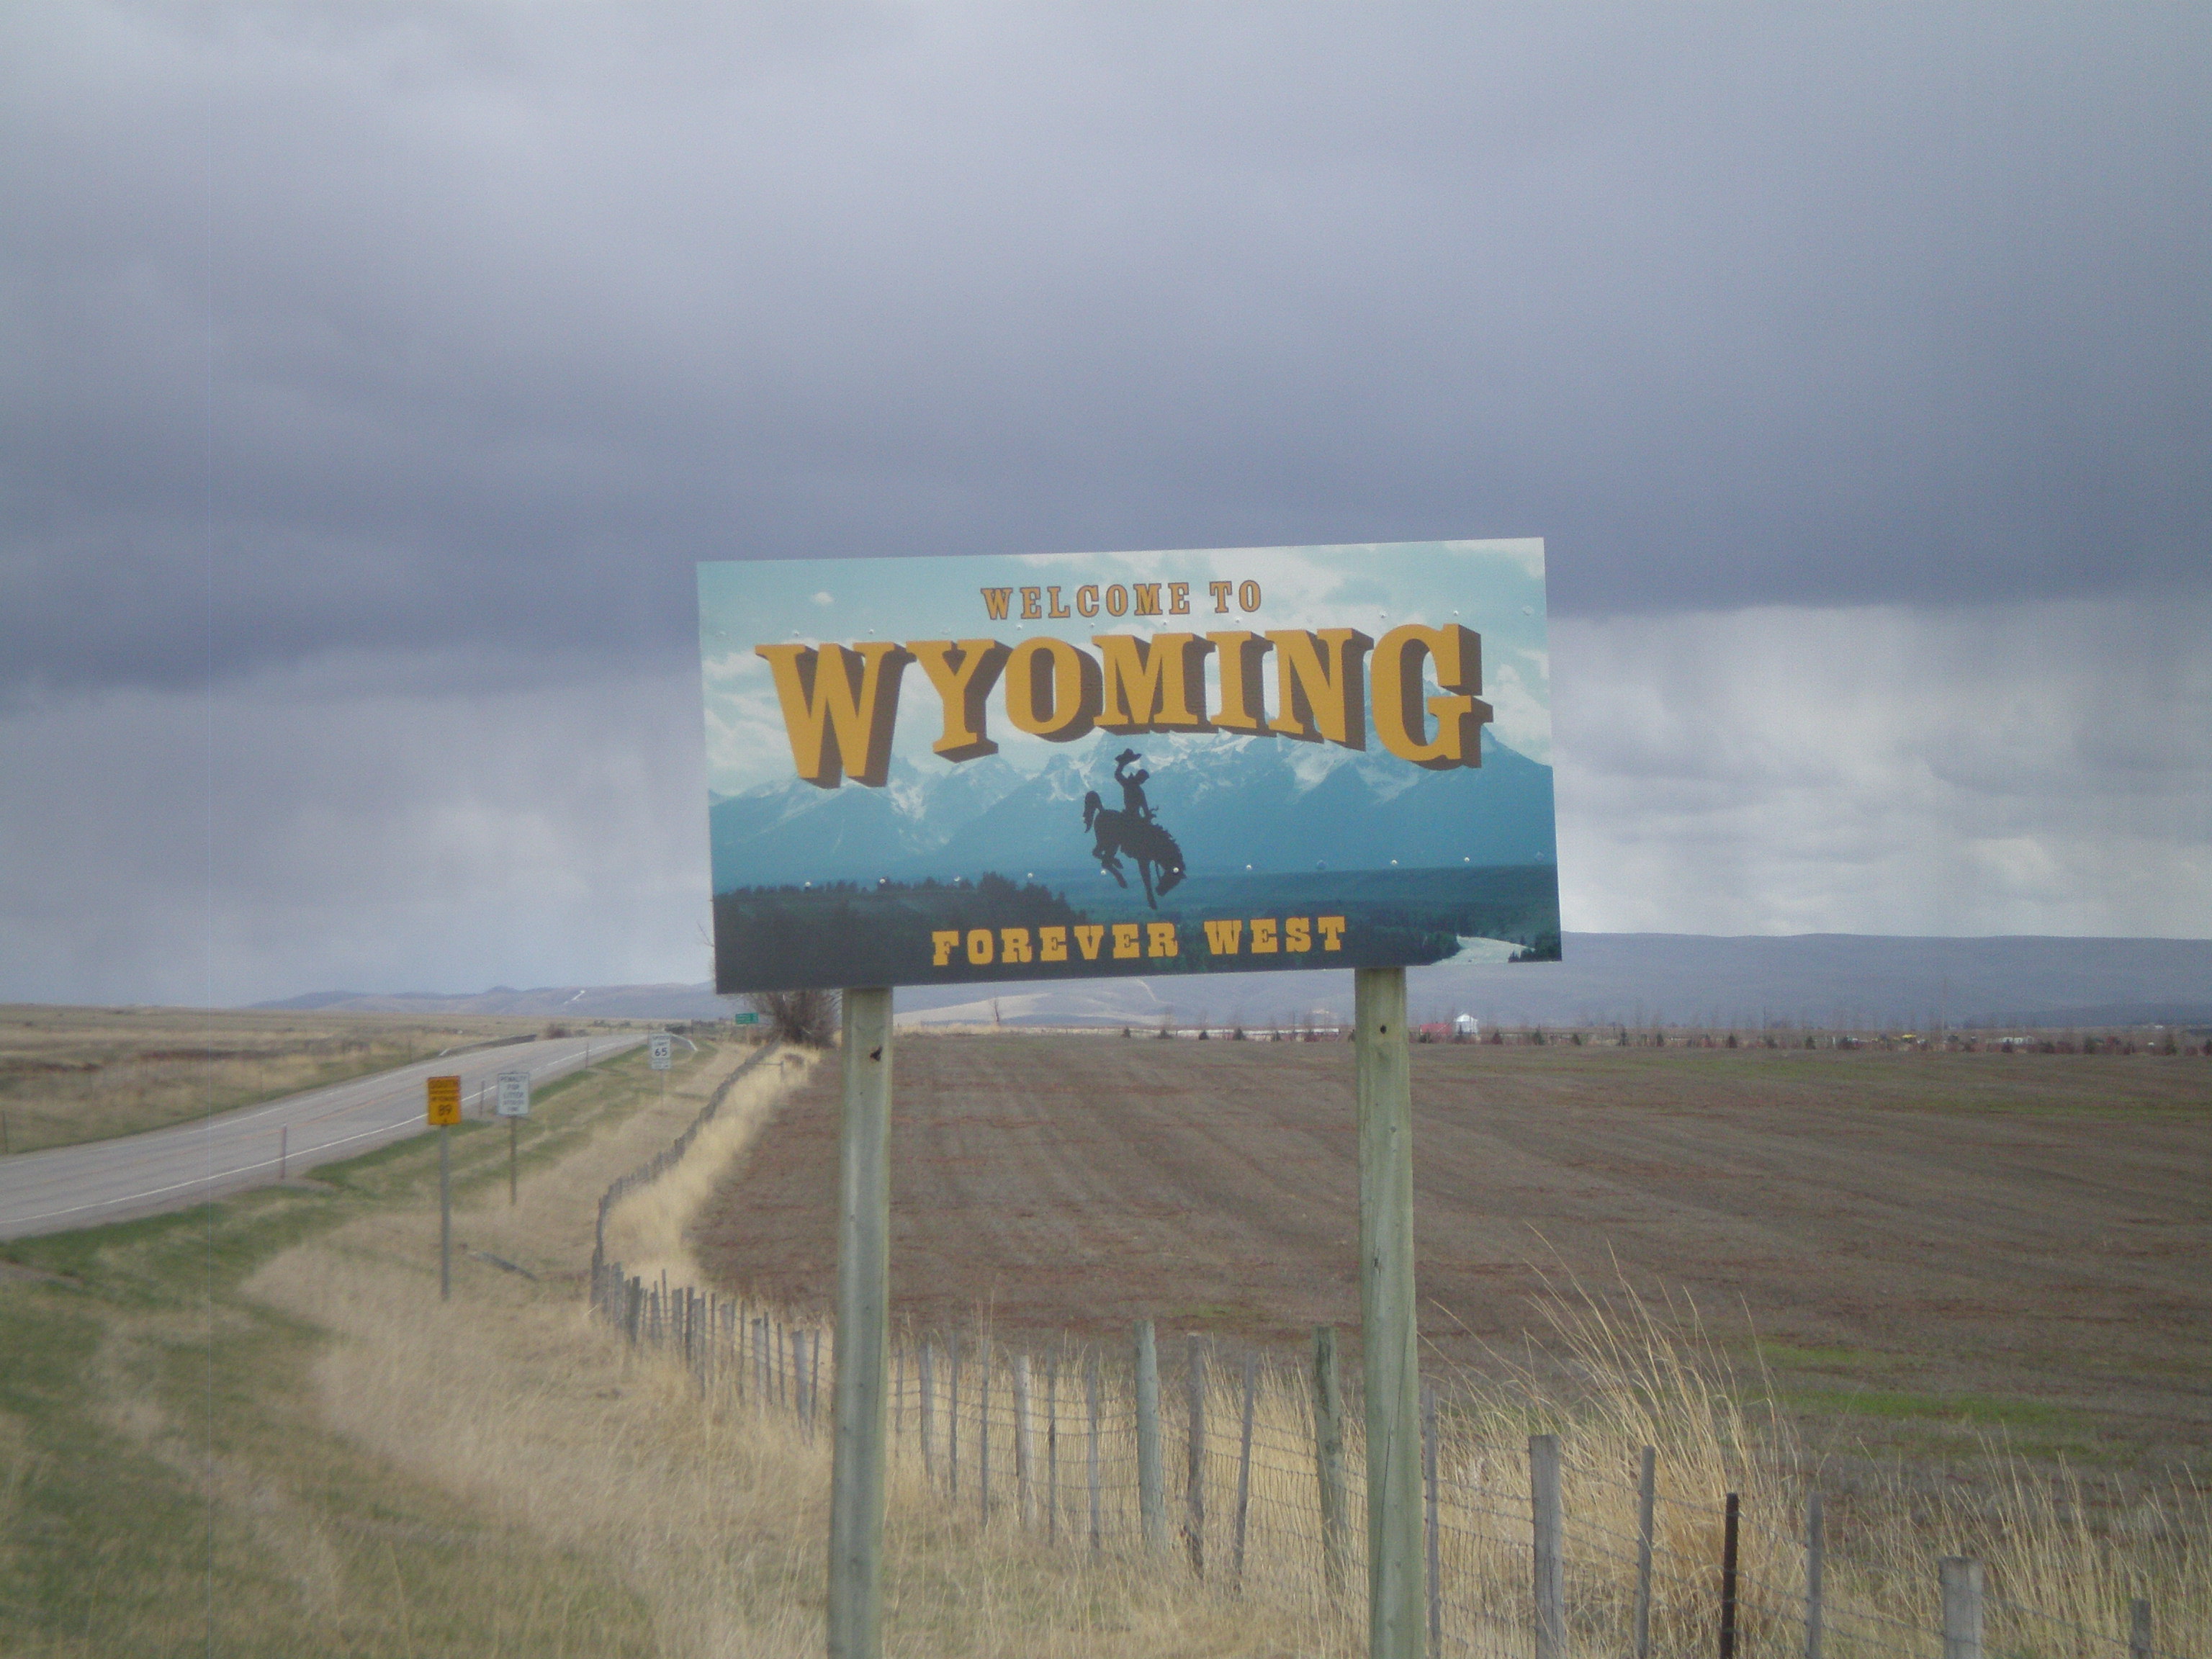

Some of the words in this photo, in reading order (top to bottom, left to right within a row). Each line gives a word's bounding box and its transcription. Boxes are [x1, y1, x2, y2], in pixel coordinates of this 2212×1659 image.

[981, 582, 1190, 620] WELCOME
[1210, 580, 1262, 613] TO
[755, 623, 1493, 789] WYOMING
[932, 922, 1179, 966] FOREVER
[1204, 916, 1346, 955] WEST
[655, 1047, 667, 1056] 65
